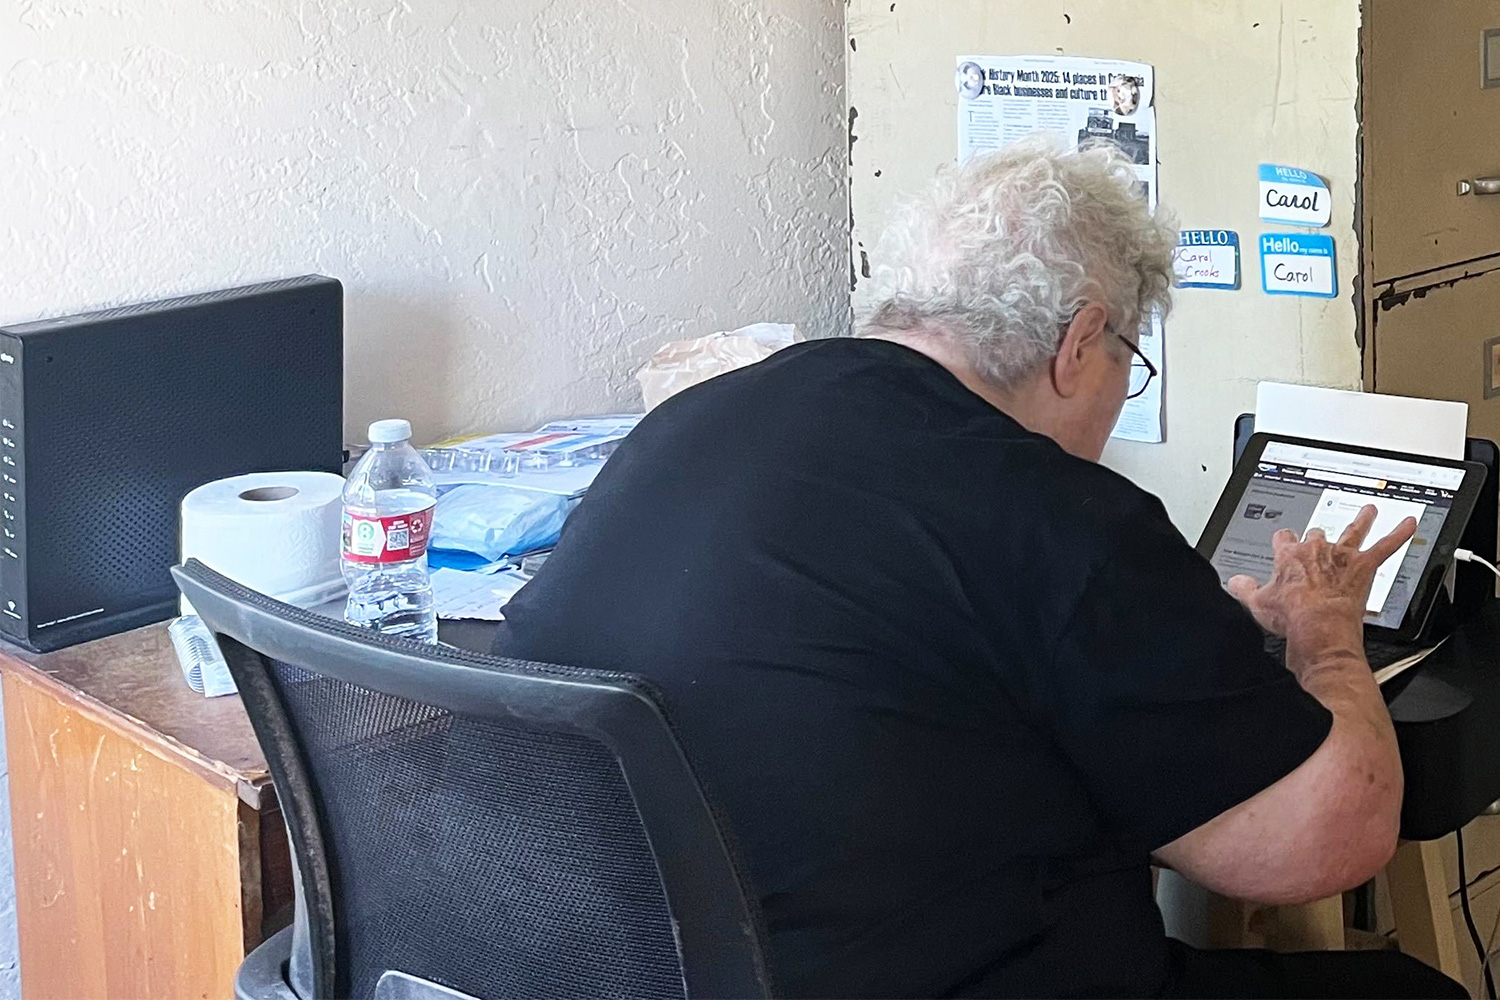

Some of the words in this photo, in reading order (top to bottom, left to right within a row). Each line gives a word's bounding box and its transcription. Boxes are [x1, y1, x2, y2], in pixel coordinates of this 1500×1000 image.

[988, 68, 1015, 83] History
[1017, 70, 1040, 82] Month
[1062, 71, 1071, 84] 14
[1073, 72, 1097, 86] places
[1099, 73, 1106, 85] in
[993, 83, 1012, 96] Black
[1013, 85, 1053, 98] businesses
[1055, 87, 1068, 99] and
[1070, 88, 1098, 100] culture
[1275, 167, 1307, 180] HELLO
[1266, 189, 1320, 212] Carol
[1178, 231, 1229, 245] HELLO
[1263, 237, 1299, 253] Hello
[1273, 263, 1314, 284] Carol
